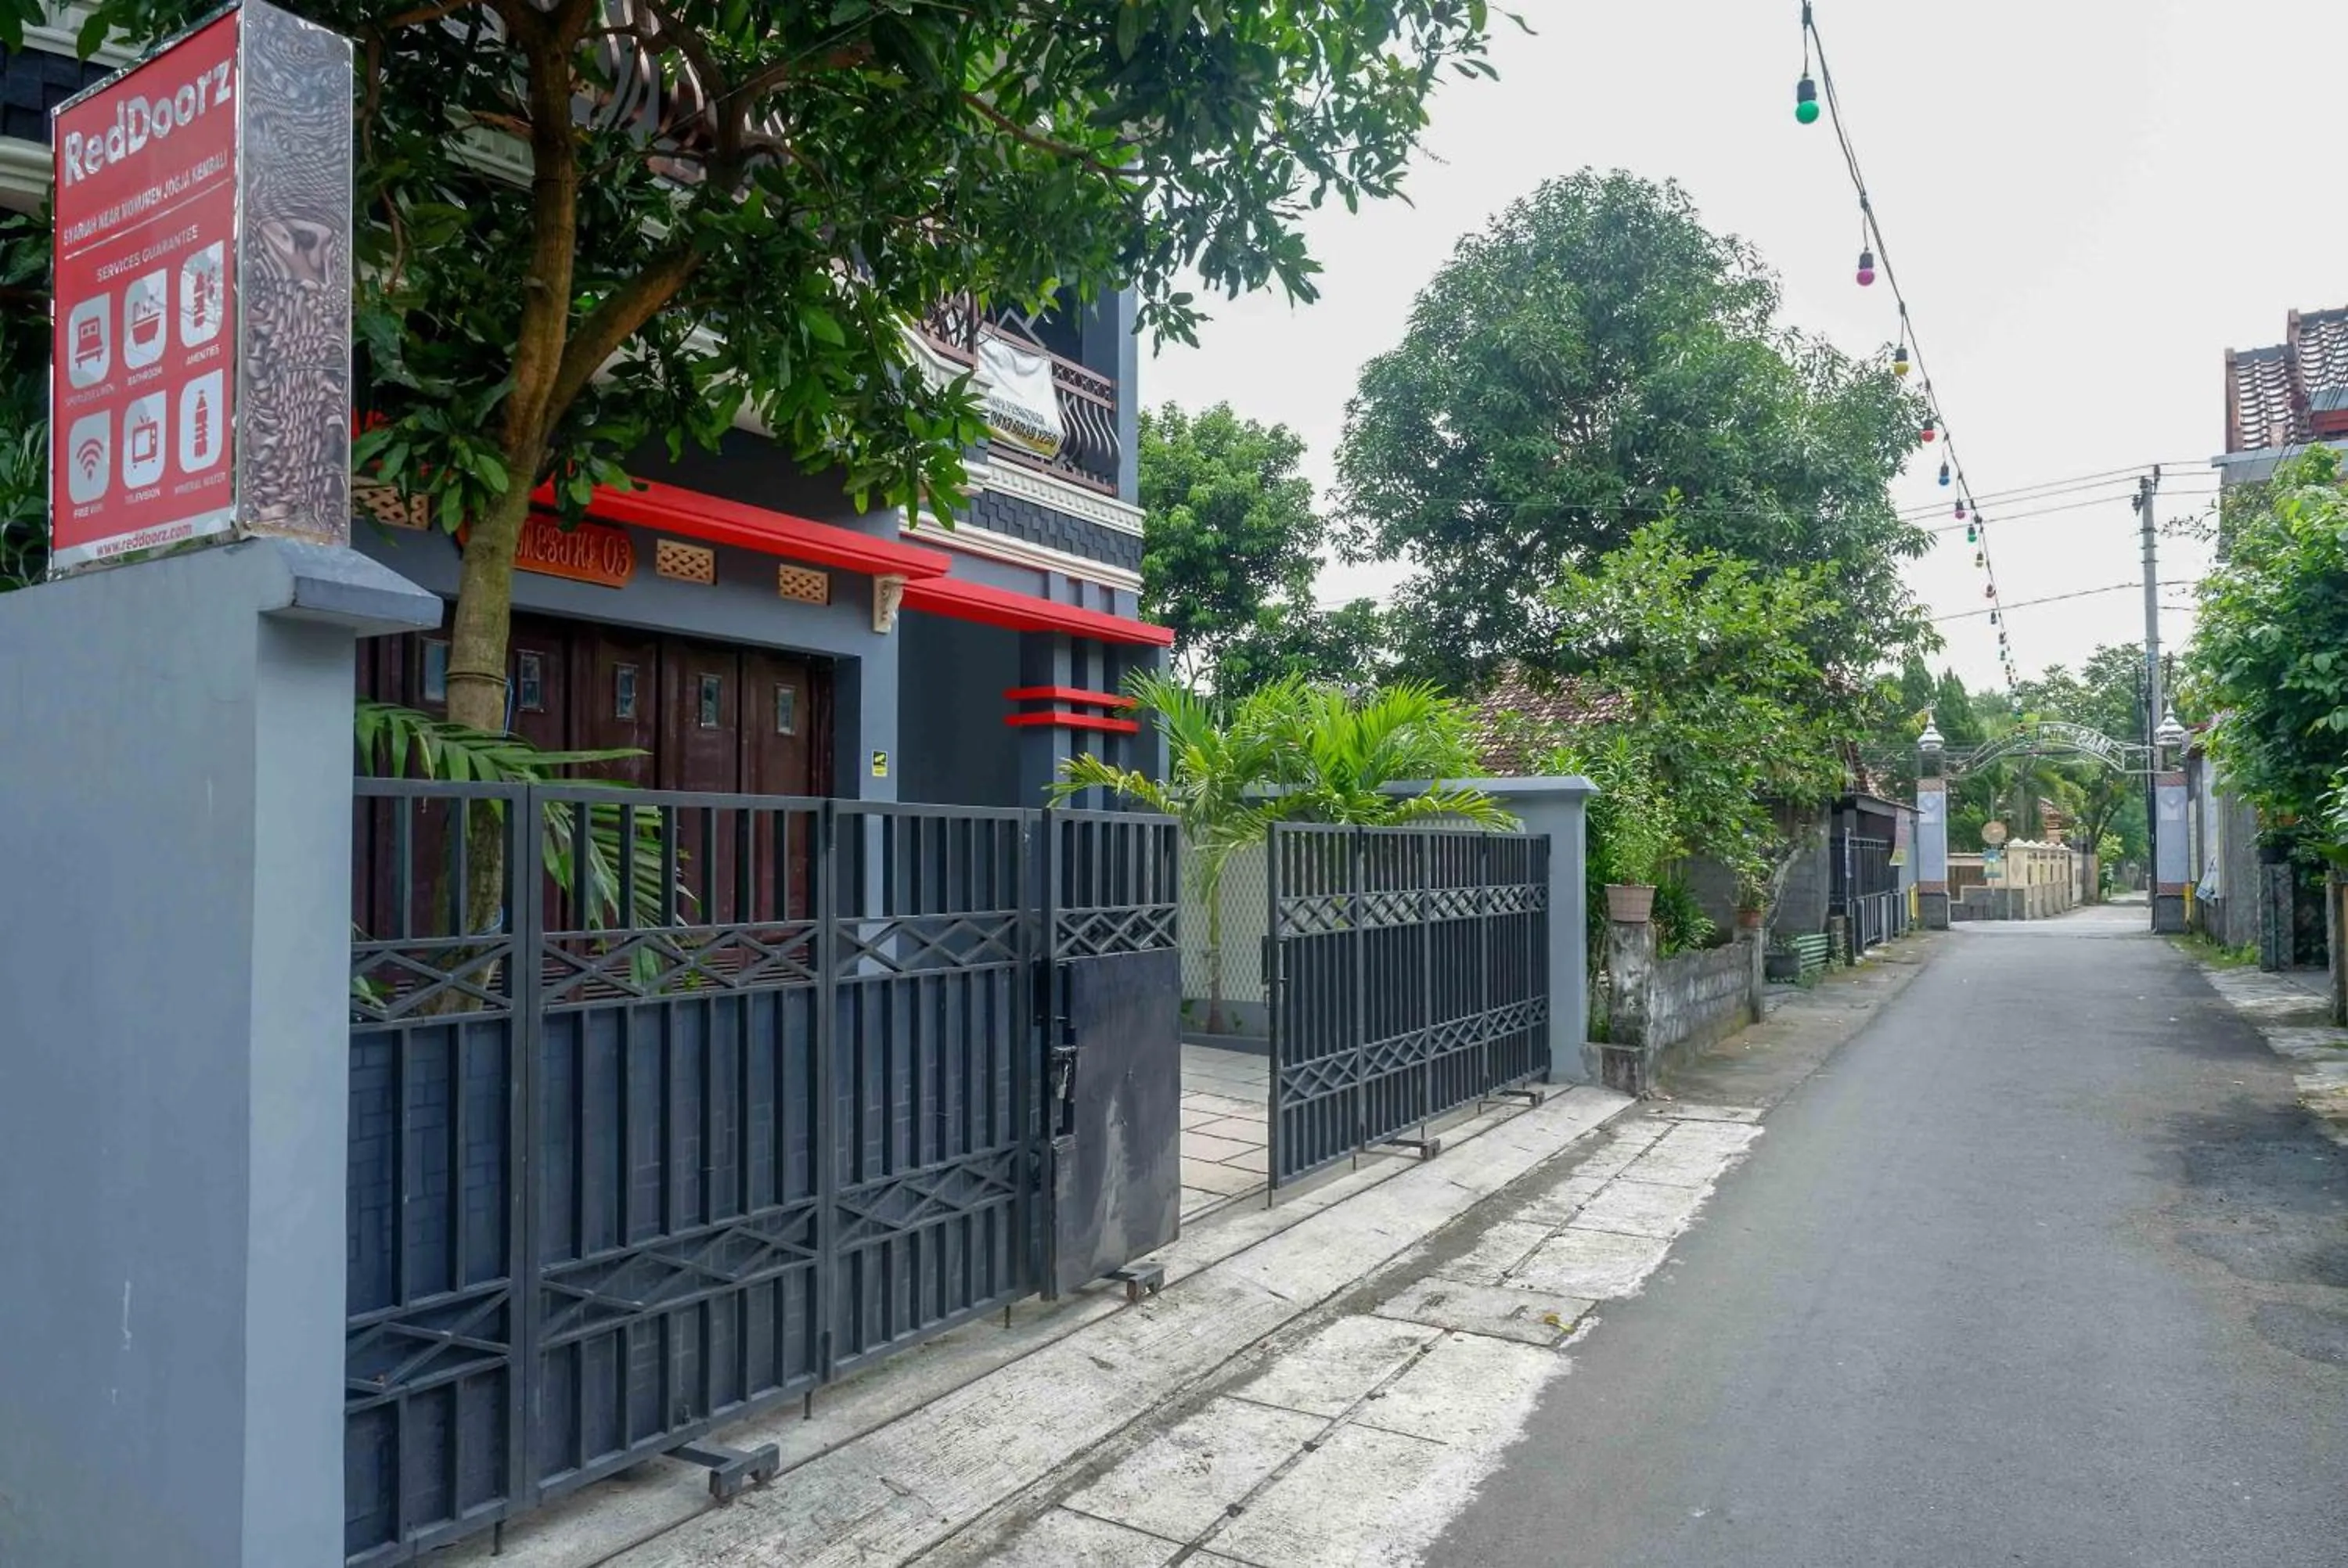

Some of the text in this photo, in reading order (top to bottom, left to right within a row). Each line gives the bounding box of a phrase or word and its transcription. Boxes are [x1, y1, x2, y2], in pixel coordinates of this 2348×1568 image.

[65, 59, 232, 188] RedDoorz
[98, 205, 120, 235] NEAR
[97, 225, 199, 282] SERVICES GUARANTEE
[185, 346, 221, 367] AMENITIES
[96, 523, 193, 557] www.reddoorz.com
